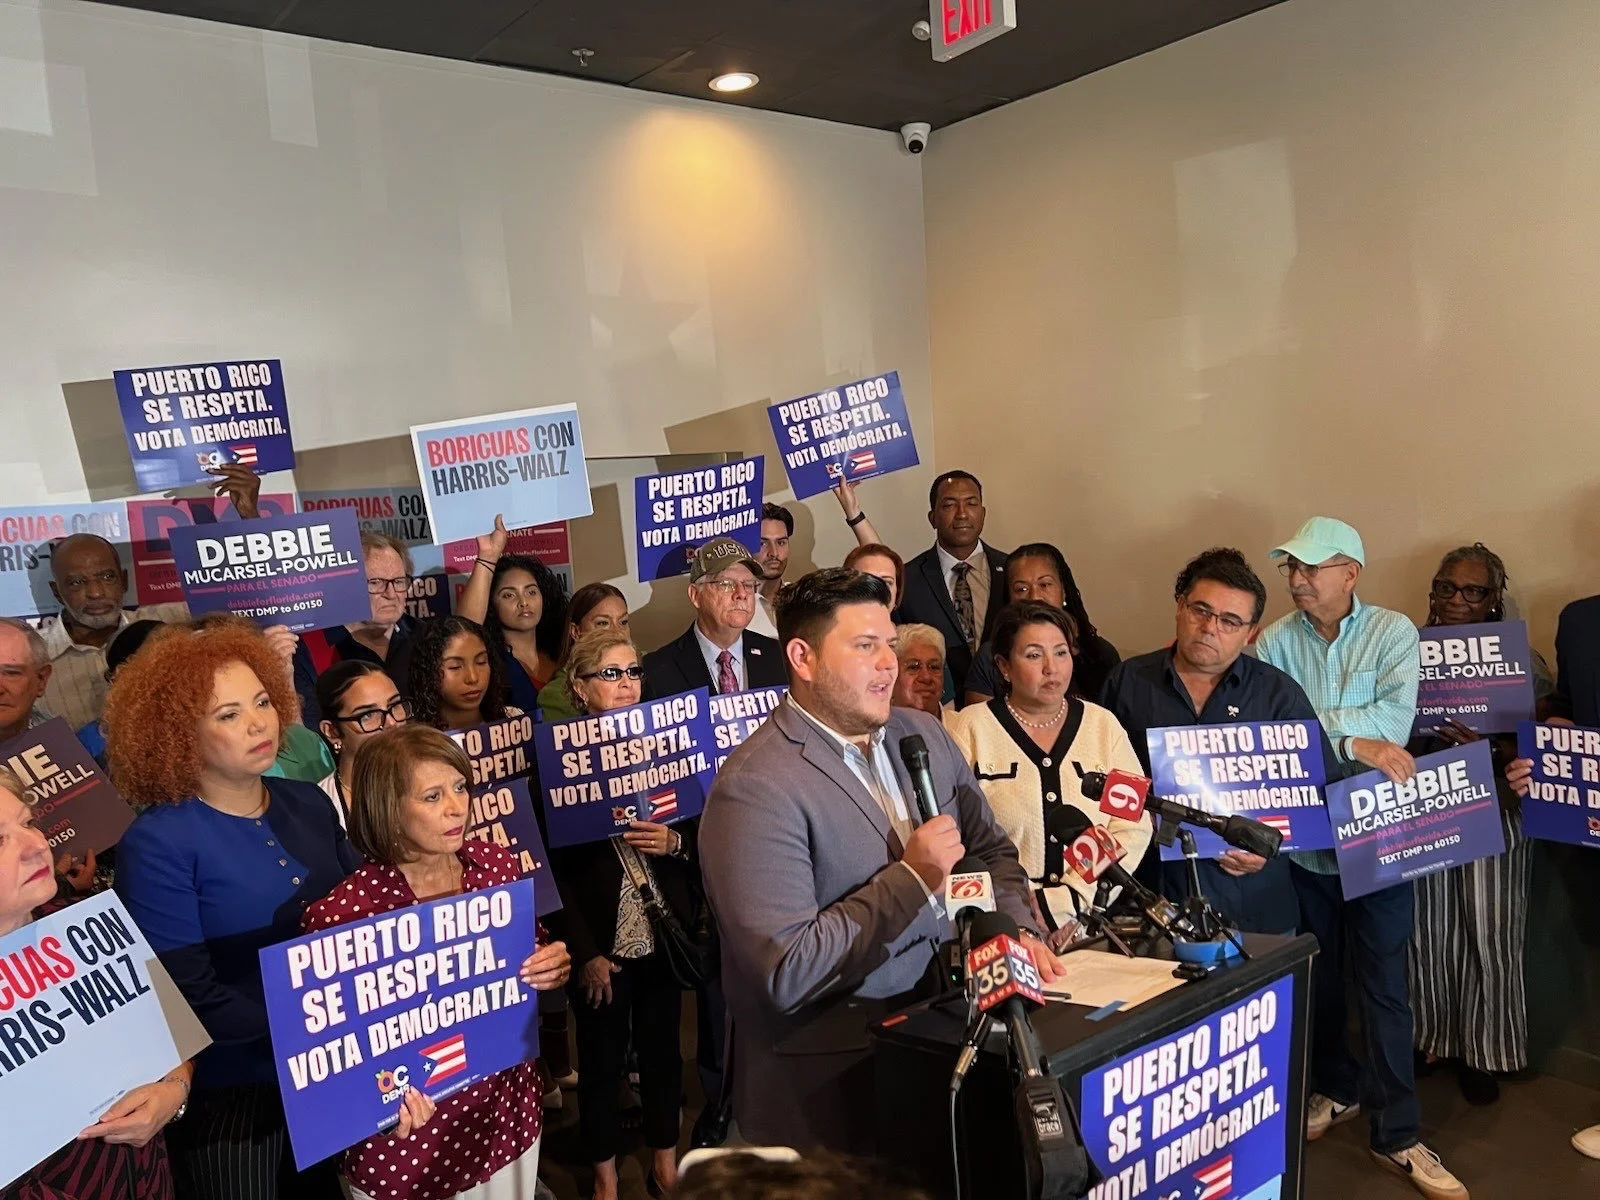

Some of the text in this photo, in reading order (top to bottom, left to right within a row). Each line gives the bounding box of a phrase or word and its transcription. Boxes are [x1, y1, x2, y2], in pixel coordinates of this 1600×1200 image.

[131, 363, 272, 397] PUERTO RICO
[142, 389, 273, 424] SE RESPETA.
[778, 377, 889, 426] PUERTO RICO
[134, 416, 287, 451] VOTA DEMÓCRATA.
[788, 402, 891, 446] SE RESPETA.
[426, 420, 576, 468] BORICUAS CON
[785, 422, 907, 469] VOTA DEMÓCRATA.
[431, 450, 570, 497] HARRIS-WALZ
[648, 460, 755, 500] PUERTO RICO
[652, 485, 751, 523] SE RESPETA.
[642, 508, 758, 548] VOTA DEMÓCRATA.
[196, 524, 334, 569] DEBBIE
[184, 551, 359, 585] MUCARSEL-POWELL
[227, 574, 317, 593] PARA EL SENADO
[256, 606, 278, 616] DMP
[293, 599, 323, 611] 60150
[553, 694, 698, 751] PUERTO RICO
[709, 690, 780, 724] PUERTO
[1422, 707, 1445, 716] DMP
[1446, 706, 1457, 714] to
[1458, 704, 1488, 714] 60150
[489, 716, 532, 751] RICO
[714, 722, 742, 749] SE
[1164, 723, 1309, 757] PUERTO RICO
[561, 750, 593, 779] SE
[600, 725, 697, 772] RESPETA.
[1173, 753, 1309, 786] SE RESPETA.
[1542, 753, 1573, 779] SE
[550, 781, 603, 808] VOTA
[608, 752, 711, 799] DEMÓCRATA.
[1219, 782, 1324, 813] DEMÓCRATA.
[1350, 759, 1470, 820] DEBBIE
[1528, 781, 1581, 806] VOTA
[611, 805, 637, 819] OC
[1337, 783, 1491, 840] MUCARSEL-POWELL
[1376, 811, 1455, 840] PARA EL SENADO
[1379, 835, 1460, 866] TEXT DMP to 60150
[953, 880, 980, 899] 6
[66, 907, 136, 966] CON
[287, 890, 512, 989] PUERTO RICO
[974, 941, 1001, 962] FOX
[1008, 940, 1029, 961] FOX
[302, 936, 506, 1034] SE RESPETA.
[977, 958, 1009, 995] 35
[1012, 957, 1039, 989] 35
[287, 1033, 363, 1091] VOTA
[368, 977, 528, 1057] DEMÓCRATA.
[1103, 990, 1277, 1118] PUERTO RICO
[377, 1065, 410, 1093] OC
[1108, 1043, 1268, 1164] SE RESPETA.
[1154, 1085, 1280, 1185] DEMÓCRATA.
